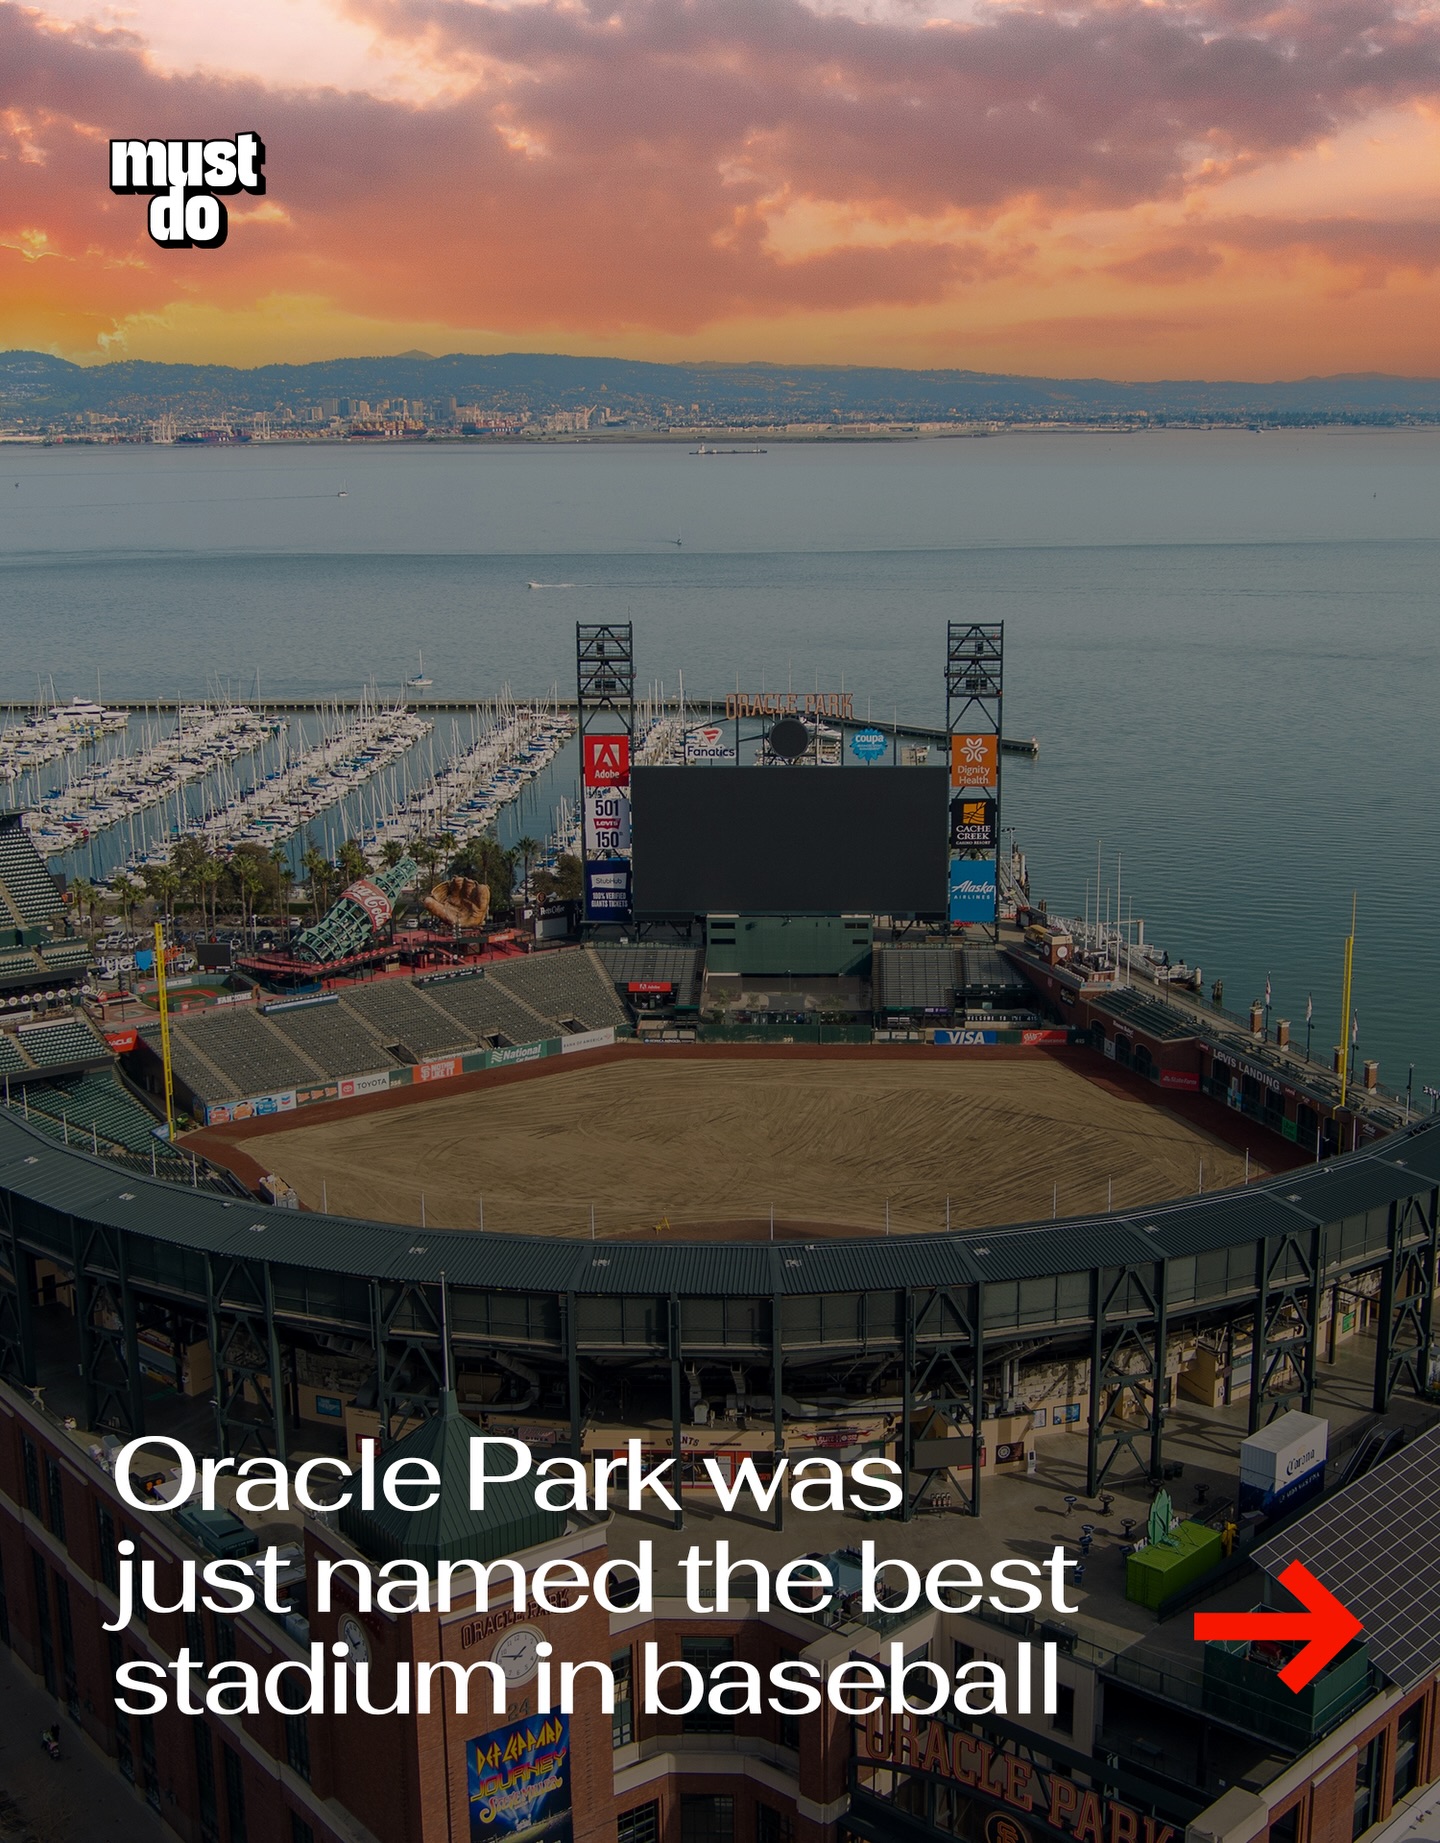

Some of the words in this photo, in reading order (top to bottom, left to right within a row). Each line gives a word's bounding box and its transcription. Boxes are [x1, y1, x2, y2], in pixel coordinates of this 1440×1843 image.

[726, 693, 798, 720] ORACLE
[804, 693, 854, 721] PARK
[855, 734, 886, 745] coupa
[687, 746, 736, 758] Fanatics
[594, 769, 620, 779] Adobe
[957, 765, 990, 779] Dignity
[959, 776, 988, 785] Health
[595, 800, 619, 817] 501
[956, 825, 991, 833] CACHE
[957, 832, 989, 840] CREEK
[595, 877, 622, 886] StubHub
[951, 880, 996, 894] Alaska
[945, 1031, 985, 1044] VISA
[503, 1044, 542, 1060] National
[1239, 1062, 1281, 1089] LANDING
[356, 1079, 387, 1090] TOYOTA
[508, 1697, 530, 1721] 24
[476, 1741, 503, 1777] DEF
[502, 1716, 564, 1763] LEPPARD
[866, 1690, 1034, 1813] ORACLE
[470, 1747, 568, 1803] JOURNEY
